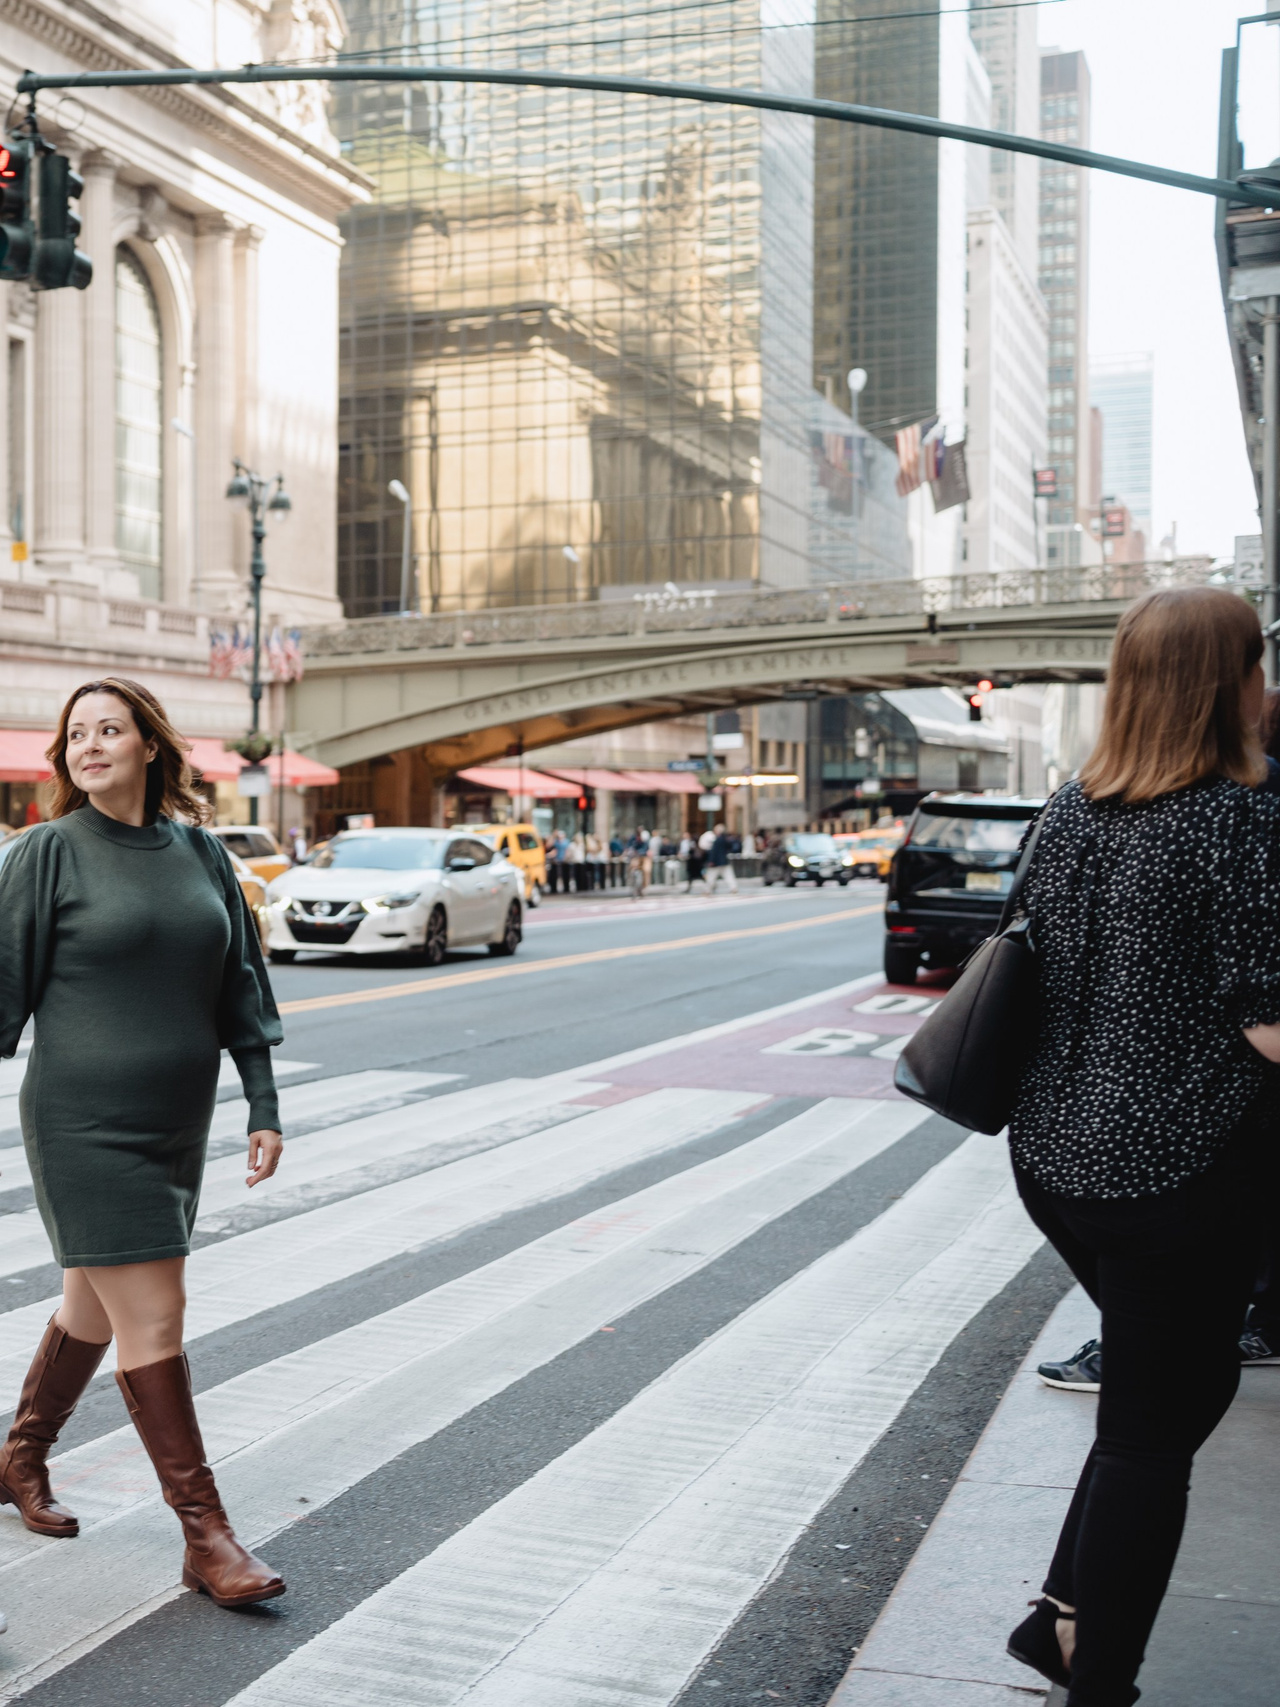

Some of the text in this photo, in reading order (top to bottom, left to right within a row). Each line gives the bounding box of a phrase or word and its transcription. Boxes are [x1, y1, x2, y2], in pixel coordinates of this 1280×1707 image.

[463, 689, 551, 720] GRAND
[568, 662, 687, 699] CENTRAL
[706, 648, 848, 678] TERMINAL
